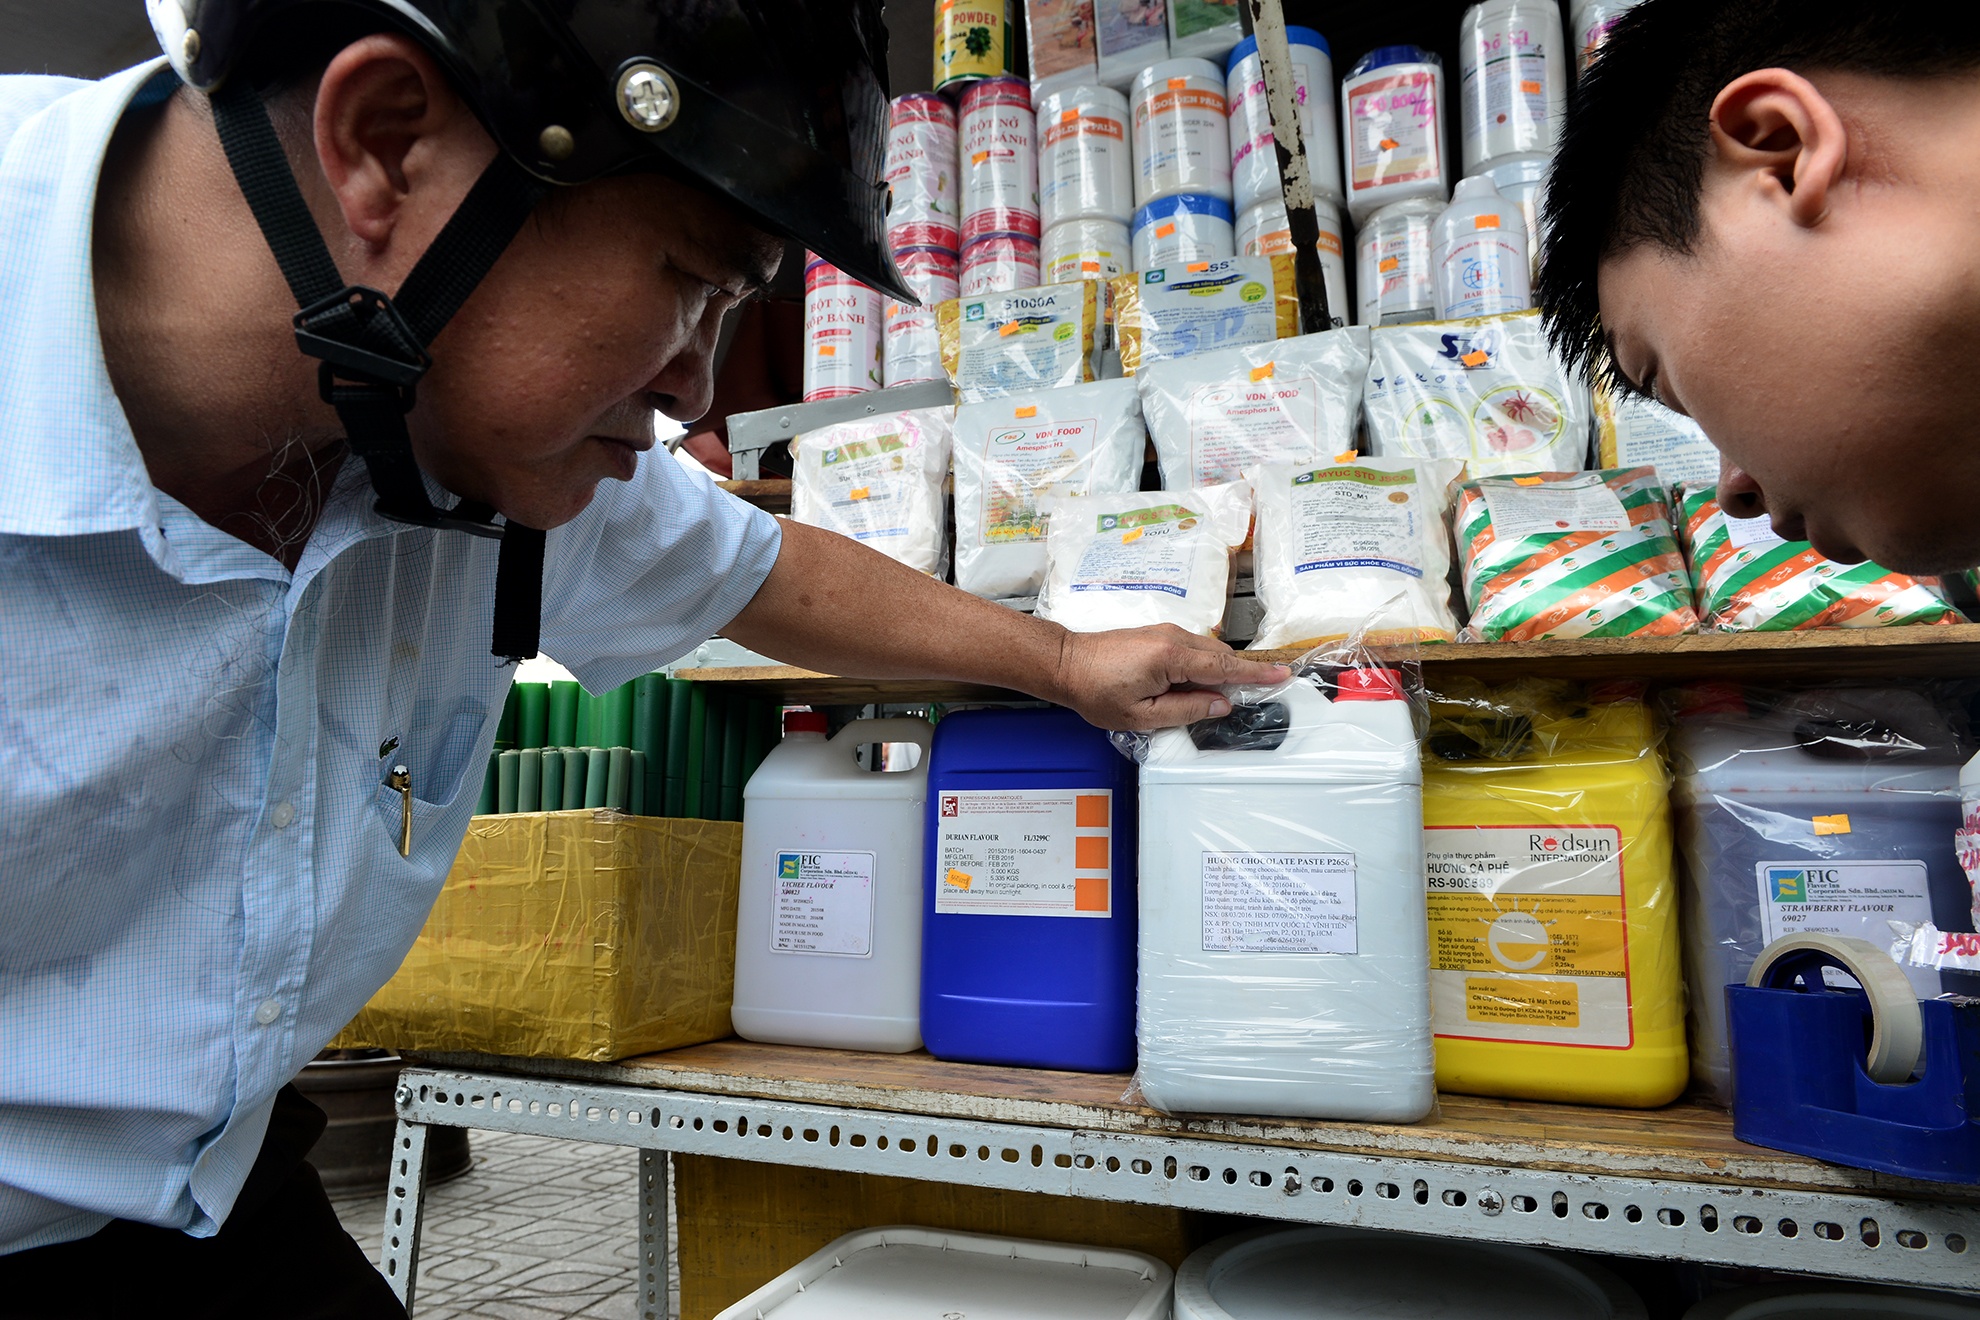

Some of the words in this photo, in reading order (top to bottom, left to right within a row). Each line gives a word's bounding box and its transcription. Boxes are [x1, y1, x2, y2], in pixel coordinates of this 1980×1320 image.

[953, 11, 997, 27] POWDER
[1153, 95, 1198, 110] GOLDEN
[1199, 96, 1224, 110] PALM
[1000, 115, 1020, 129] NỞ
[1091, 123, 1118, 135] PALM
[1052, 262, 1076, 275] Coffee
[810, 296, 833, 313] BỘT
[837, 295, 857, 308] NỞ
[1005, 296, 1056, 311] S1000A
[827, 310, 865, 326] BÁNH
[1226, 406, 1267, 416] Amesphos
[1016, 442, 1053, 452] Amesphos
[1054, 441, 1064, 449] H1
[1318, 469, 1351, 479] MYUC
[1354, 470, 1376, 481] STD
[1335, 490, 1368, 500] STD_M1
[1121, 513, 1148, 525] MYUC
[1151, 509, 1171, 520] STD
[1144, 528, 1170, 537] TOFU
[1604, 542, 1616, 550] NEO
[1564, 559, 1576, 567] NEO
[1740, 553, 1753, 563] NEO
[1300, 564, 1314, 572] SẢN
[1315, 560, 1334, 569] PHẨM
[1344, 559, 1359, 567] SỨC
[1381, 561, 1400, 571] CỘNG
[1401, 565, 1419, 576] ĐỒNG
[1818, 567, 1831, 576] NEO
[1164, 585, 1181, 595] ĐỒNG
[1634, 589, 1645, 597] NEO
[1589, 612, 1602, 622] NEO
[1878, 610, 1894, 621] NEO
[1529, 834, 1611, 852] Redsun
[801, 855, 821, 866] FIC
[1427, 852, 1440, 860] Phụ
[1456, 852, 1472, 860] thực
[1475, 851, 1495, 860] phẩm
[1530, 853, 1611, 863] INTERNATIONAL
[1240, 857, 1295, 865] CHOCOLATE
[1298, 858, 1326, 866] PASTE
[1327, 858, 1350, 866] P2656
[1427, 862, 1467, 874] HƯƠNG
[1469, 861, 1485, 874] CÀ
[1487, 861, 1510, 874] PHÊ
[1806, 870, 1839, 883] FIC
[996, 882, 1016, 890] original
[1781, 904, 1845, 912] STRAWBERRY
[1848, 904, 1894, 912] FLAVOUR
[1782, 914, 1807, 922] 69027
